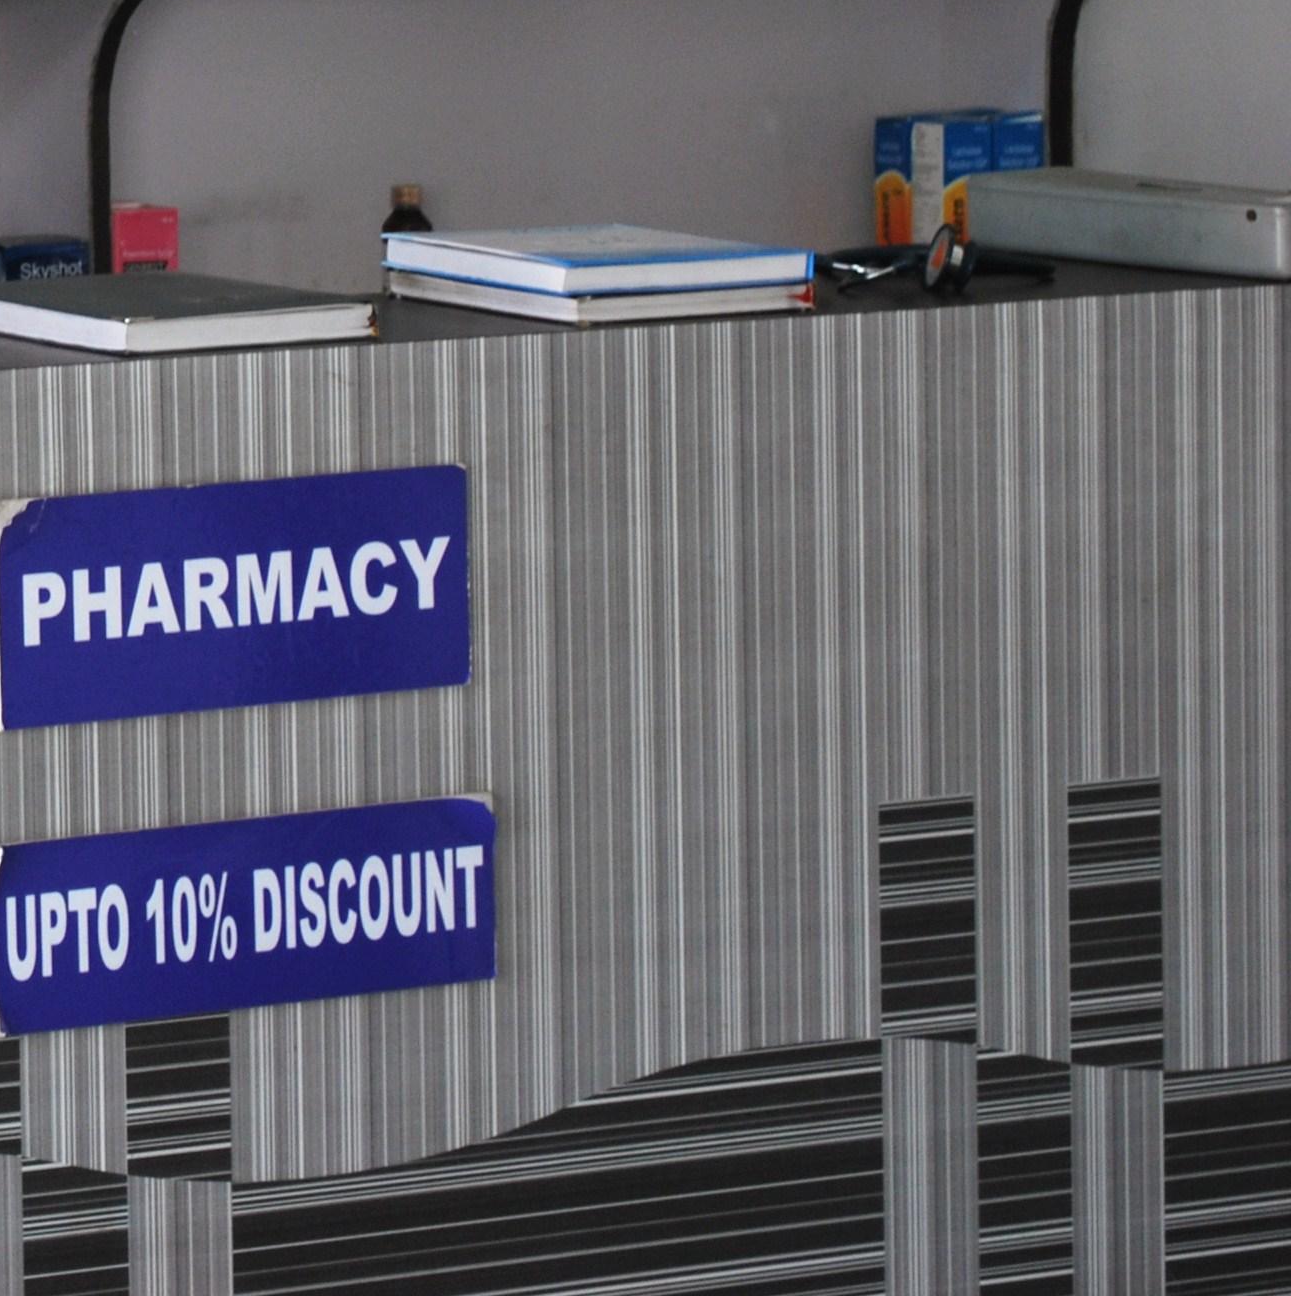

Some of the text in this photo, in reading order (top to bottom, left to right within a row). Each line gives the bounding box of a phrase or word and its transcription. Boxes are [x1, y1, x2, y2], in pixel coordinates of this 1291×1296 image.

[20, 261, 83, 281] Skyshot
[22, 536, 451, 647] PHARMACY
[6, 844, 485, 982] UPTO 10% DISCOUNT
